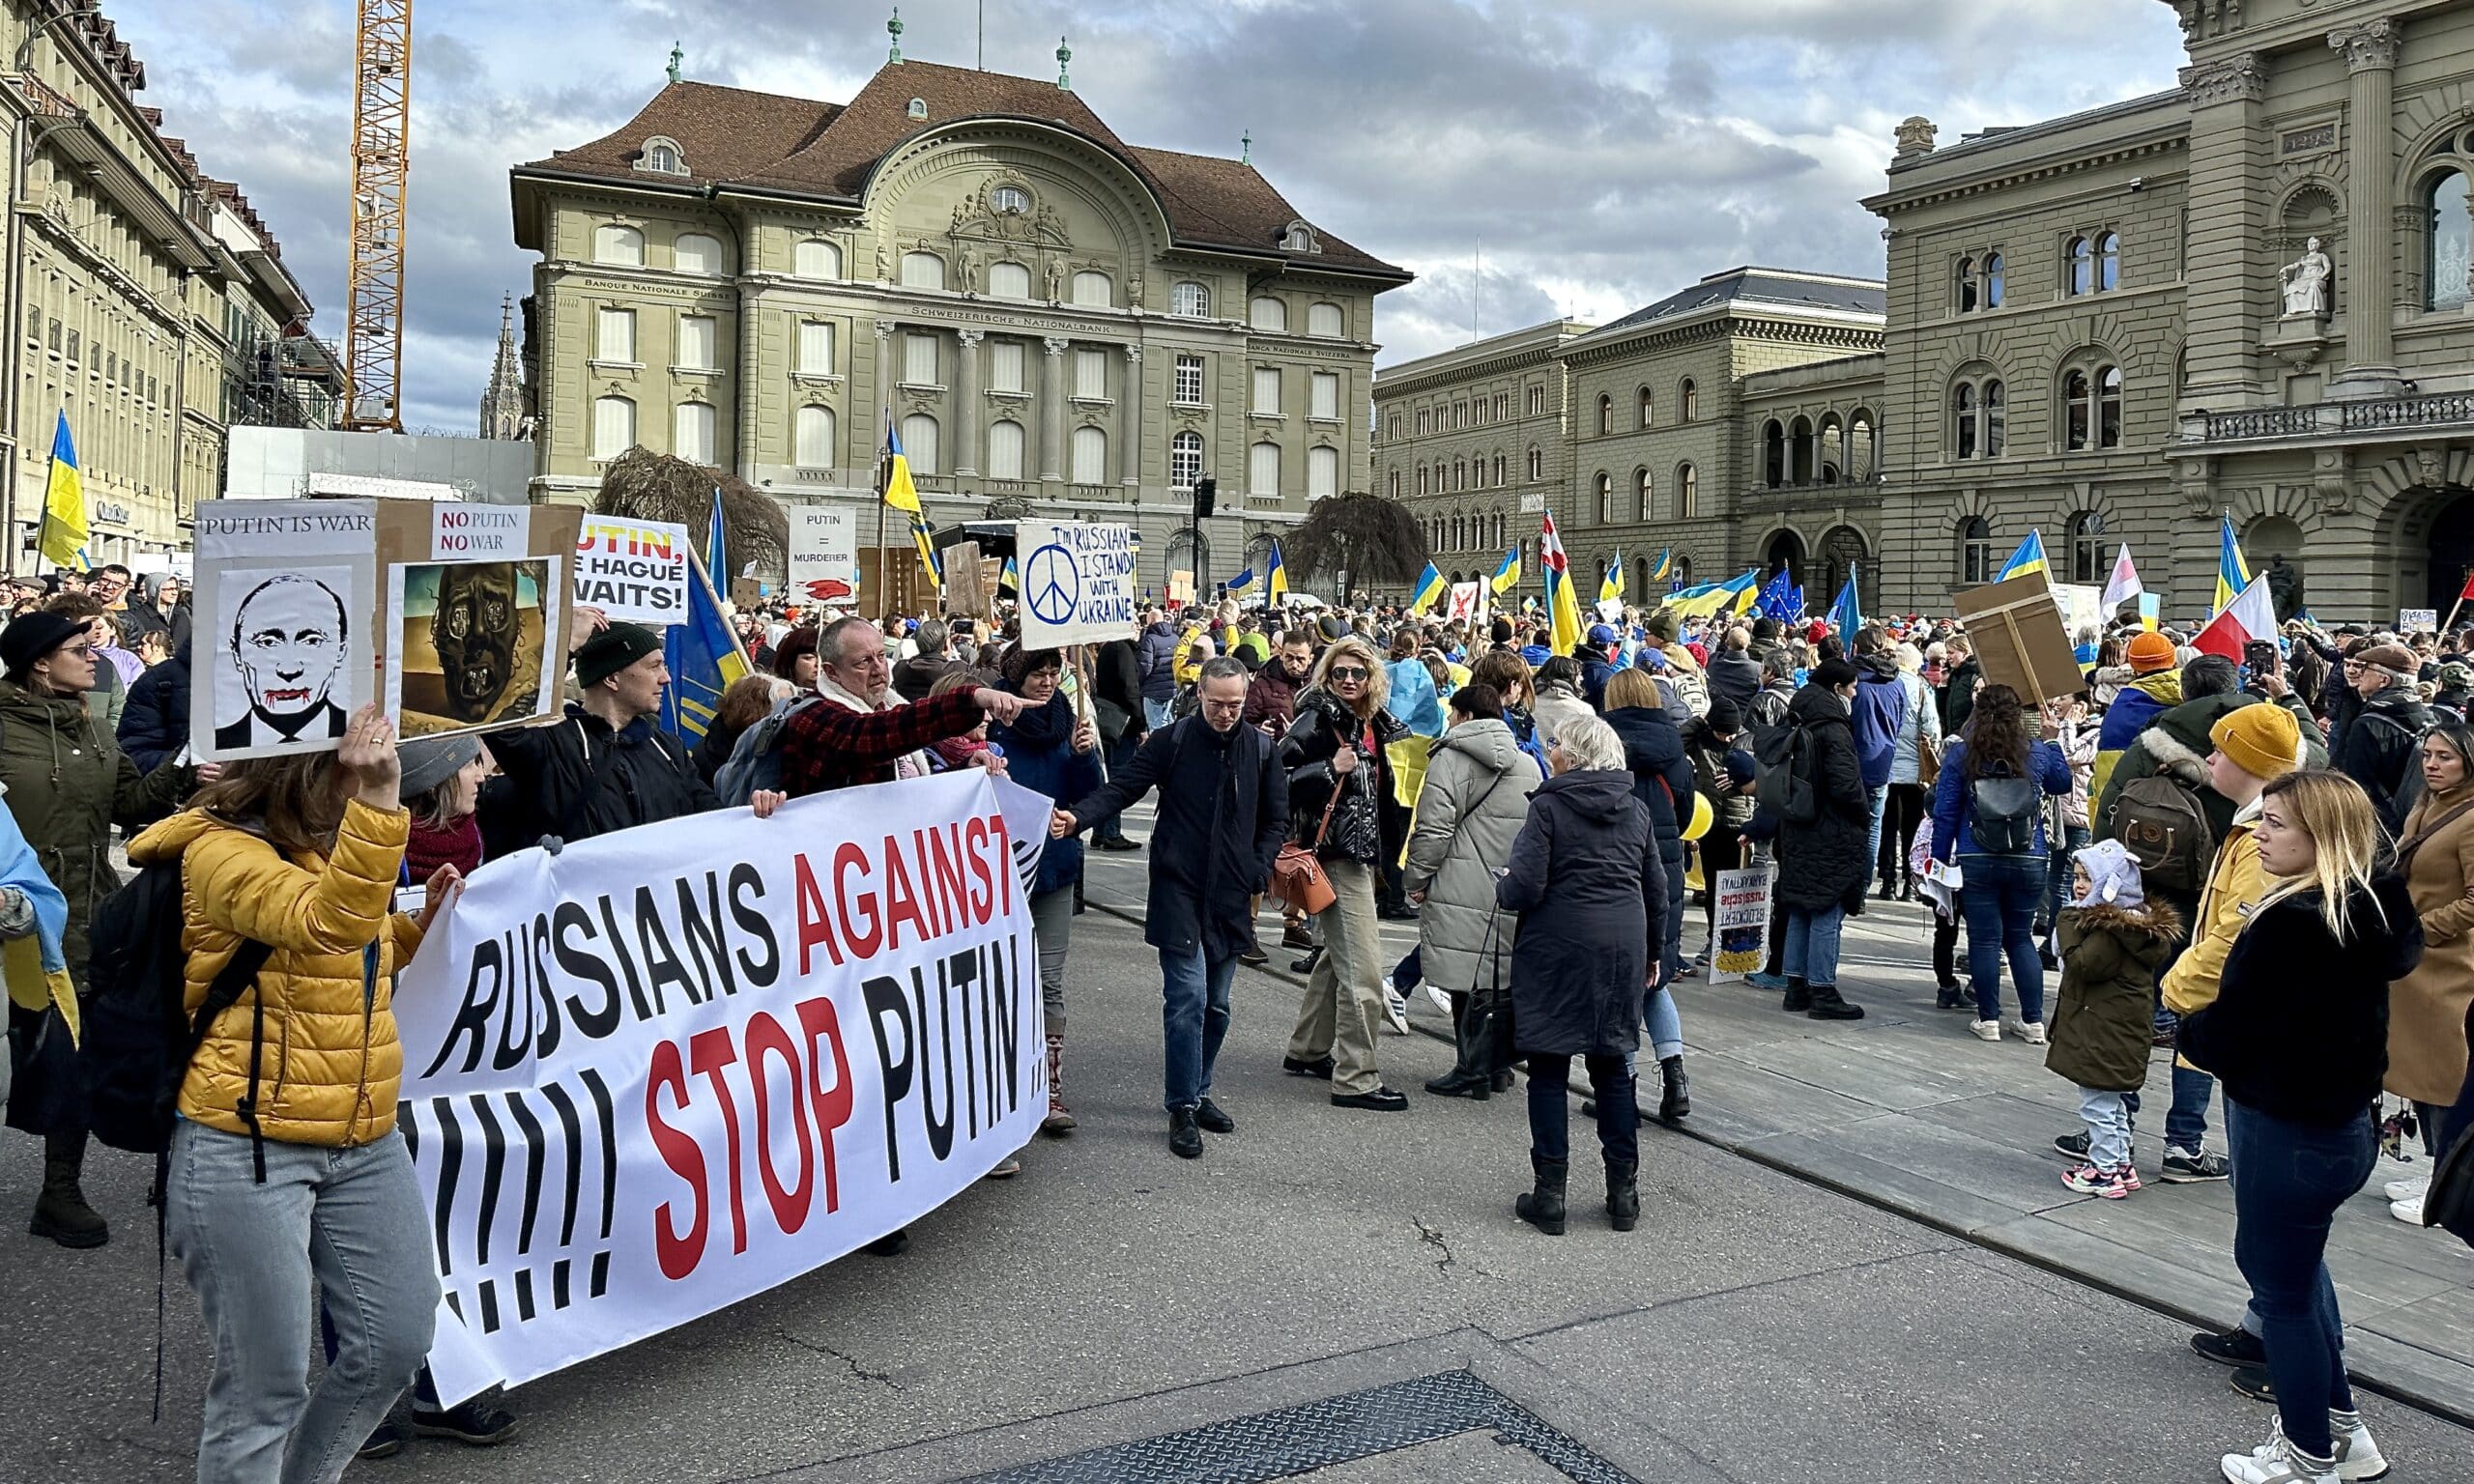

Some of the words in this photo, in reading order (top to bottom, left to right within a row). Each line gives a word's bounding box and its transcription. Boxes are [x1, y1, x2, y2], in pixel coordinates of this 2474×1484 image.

[585, 279, 627, 290] BANQUE
[633, 284, 687, 296] NATIONALE
[693, 290, 731, 300] SUISSE
[911, 306, 1015, 324] SCHWEIZERISCHE
[1023, 317, 1110, 333] NATIONALBANK
[1273, 346, 1312, 356] NAZIONALE
[204, 517, 284, 536] PUTIN
[292, 516, 311, 533] IS
[317, 514, 371, 532] WAR
[441, 511, 469, 528] NO
[472, 513, 518, 528] PUTIN
[806, 515, 841, 526] PUTIN
[441, 534, 468, 551] NO
[470, 534, 503, 550] WAR
[575, 525, 683, 565] UTIN,
[1074, 527, 1128, 553] RUSSIAN
[591, 557, 683, 582] HAGUE
[793, 554, 849, 562] MURDERER
[1079, 555, 1091, 579] I
[1092, 552, 1133, 578] STAND
[574, 578, 682, 610] WAITS!
[1089, 579, 1119, 596] WITH
[1079, 597, 1133, 624] UKRAINE
[420, 862, 781, 1080] RUSSIANS
[794, 813, 1011, 976] AGAINST
[645, 997, 854, 1281] STOP
[862, 933, 1020, 1184] PUTIN
